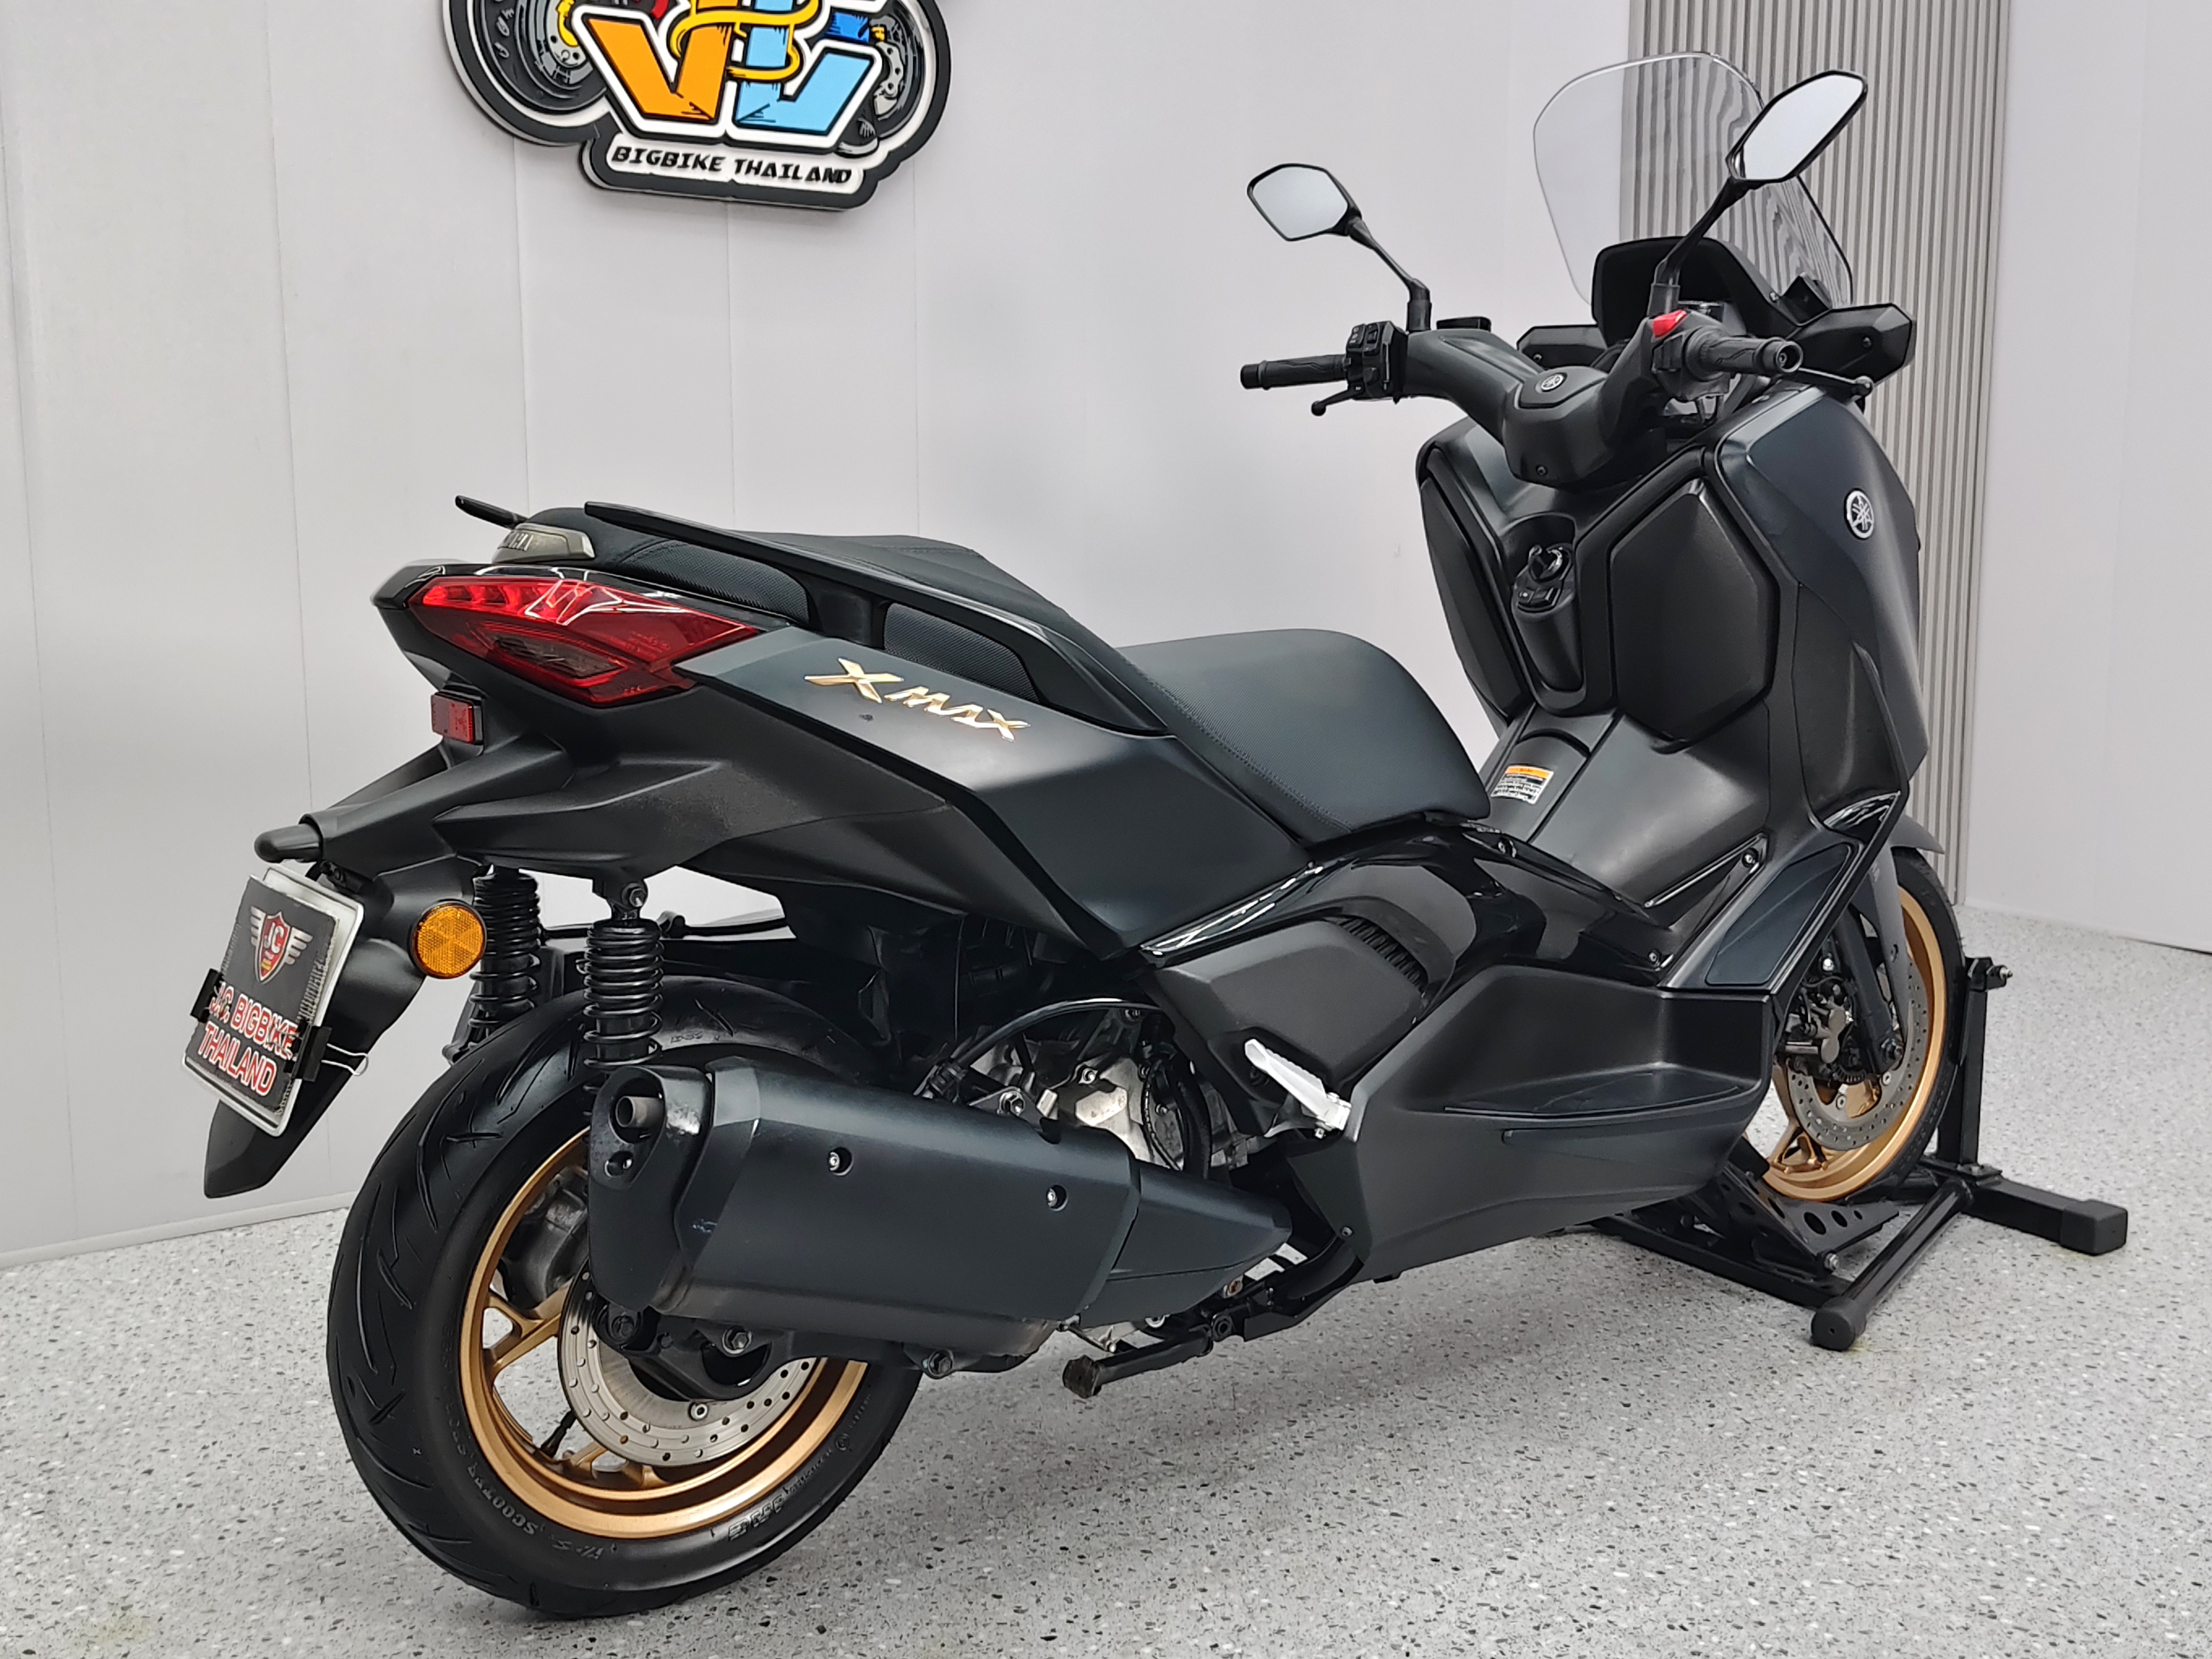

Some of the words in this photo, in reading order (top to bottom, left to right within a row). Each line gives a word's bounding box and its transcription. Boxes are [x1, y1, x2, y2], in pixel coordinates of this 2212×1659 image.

[611, 145, 726, 172] BIGBIKE
[734, 158, 852, 184] THAILAND
[264, 921, 285, 954] JC
[230, 993, 299, 1061] BIGBIKE
[198, 1020, 277, 1096] THAILAND
